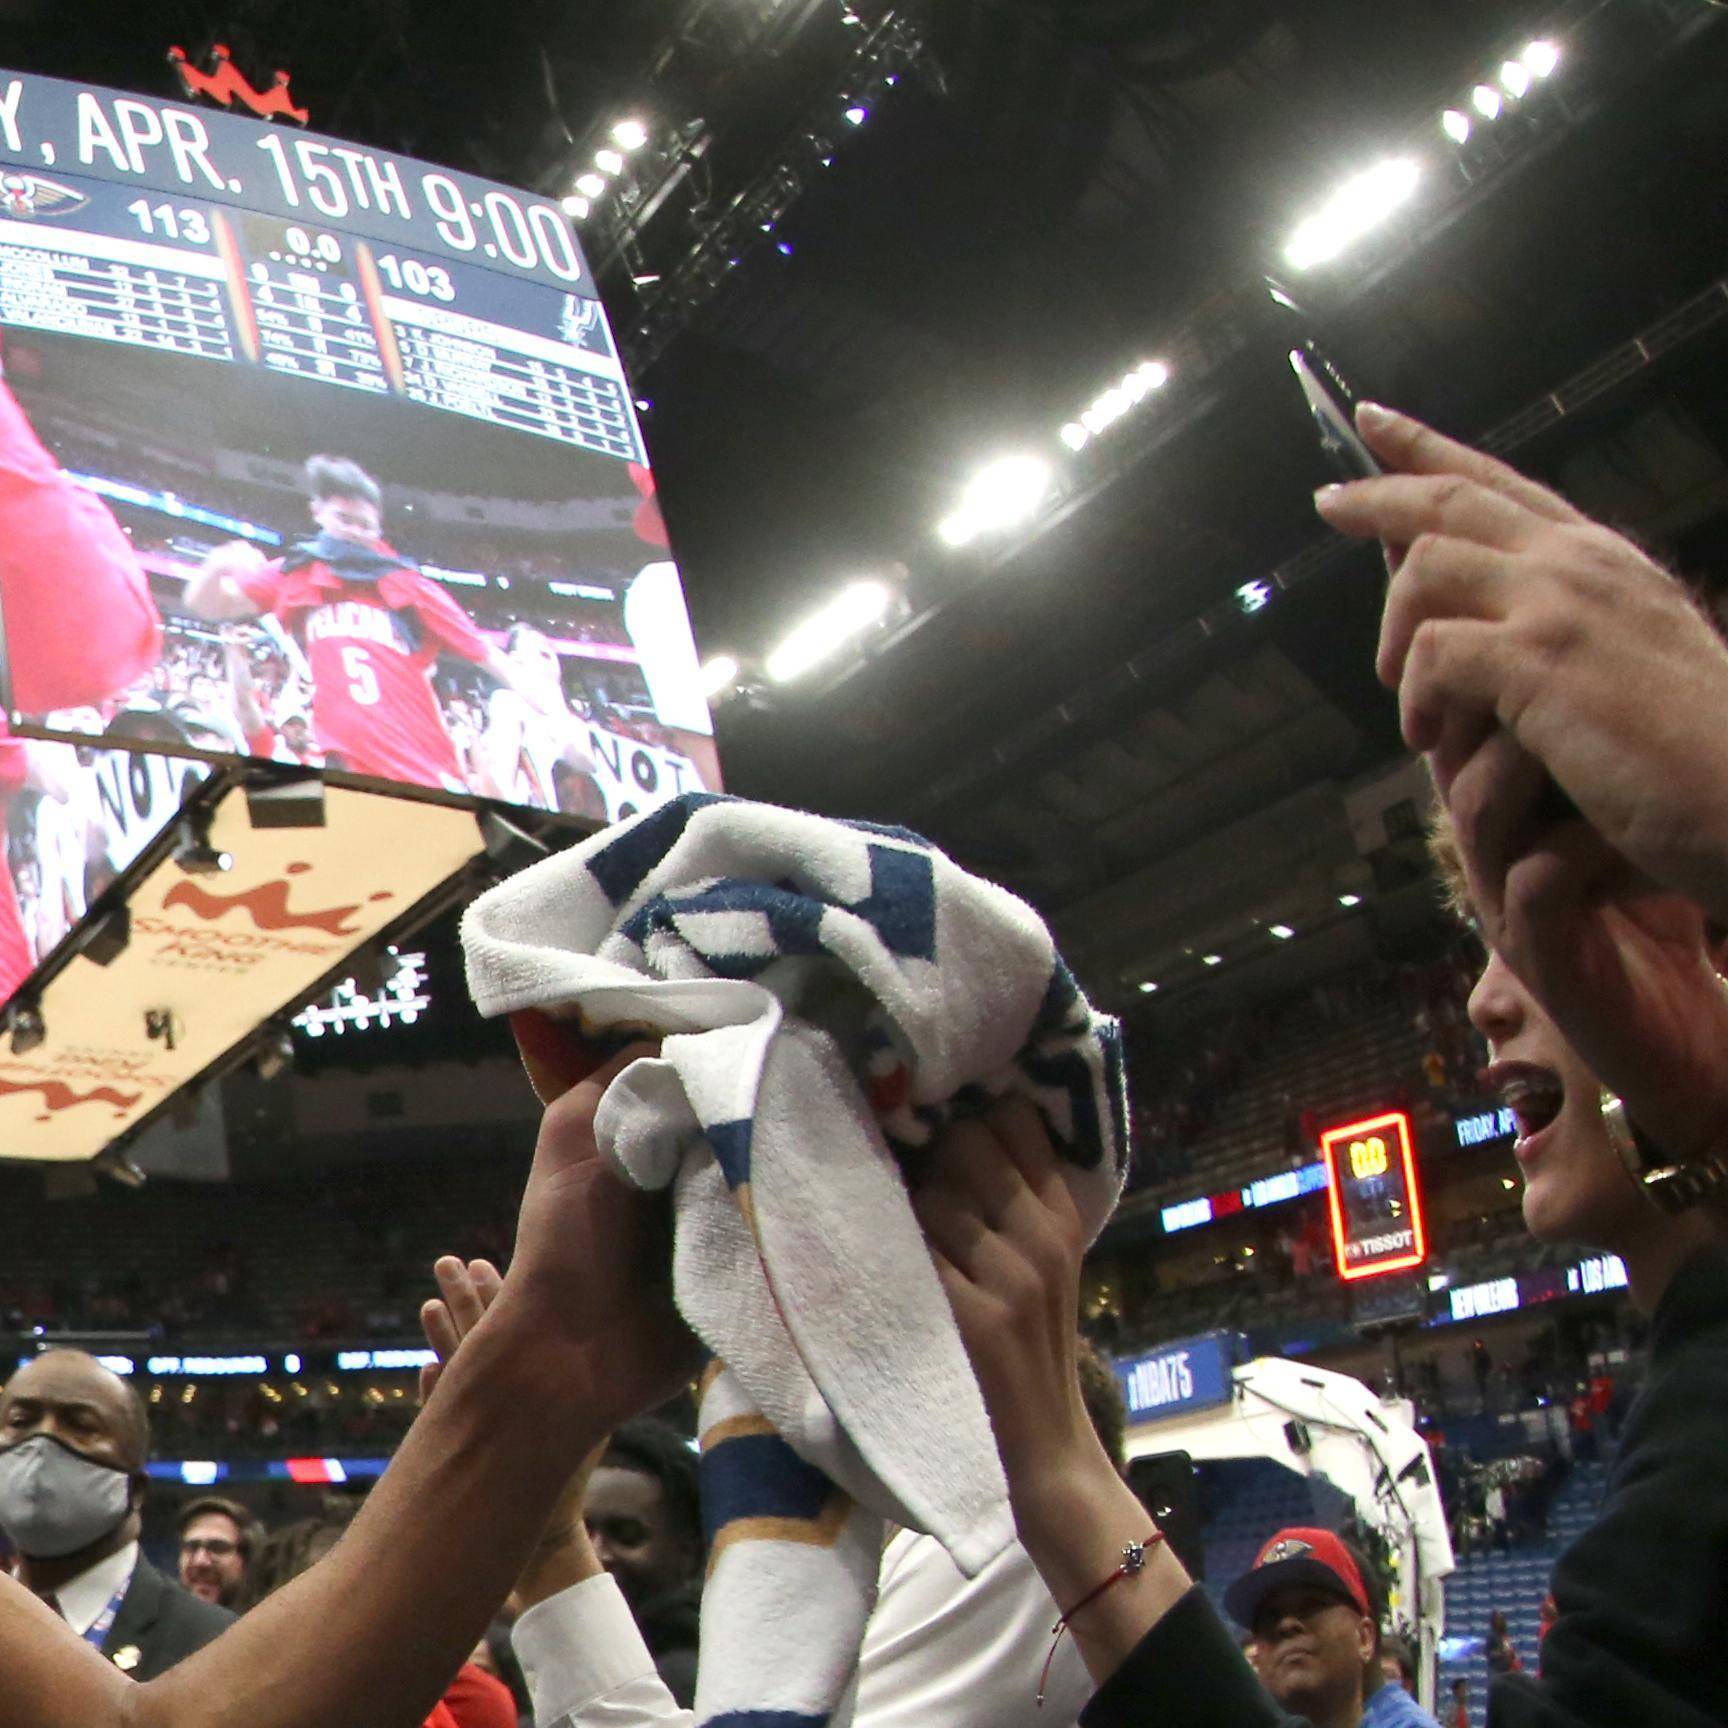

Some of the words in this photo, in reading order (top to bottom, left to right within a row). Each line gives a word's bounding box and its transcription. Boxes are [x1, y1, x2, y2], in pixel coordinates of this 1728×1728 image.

[77, 92, 242, 194] APR.
[256, 133, 411, 220] 15TH
[422, 173, 580, 282] 9:00
[127, 199, 210, 244] 113
[285, 226, 341, 263] 0.0
[378, 254, 455, 302] 103
[341, 645, 380, 706] 5
[587, 728, 685, 794] NOT
[1361, 1229, 1413, 1256] TISSOT
[1127, 1350, 1194, 1413] #NBA75
